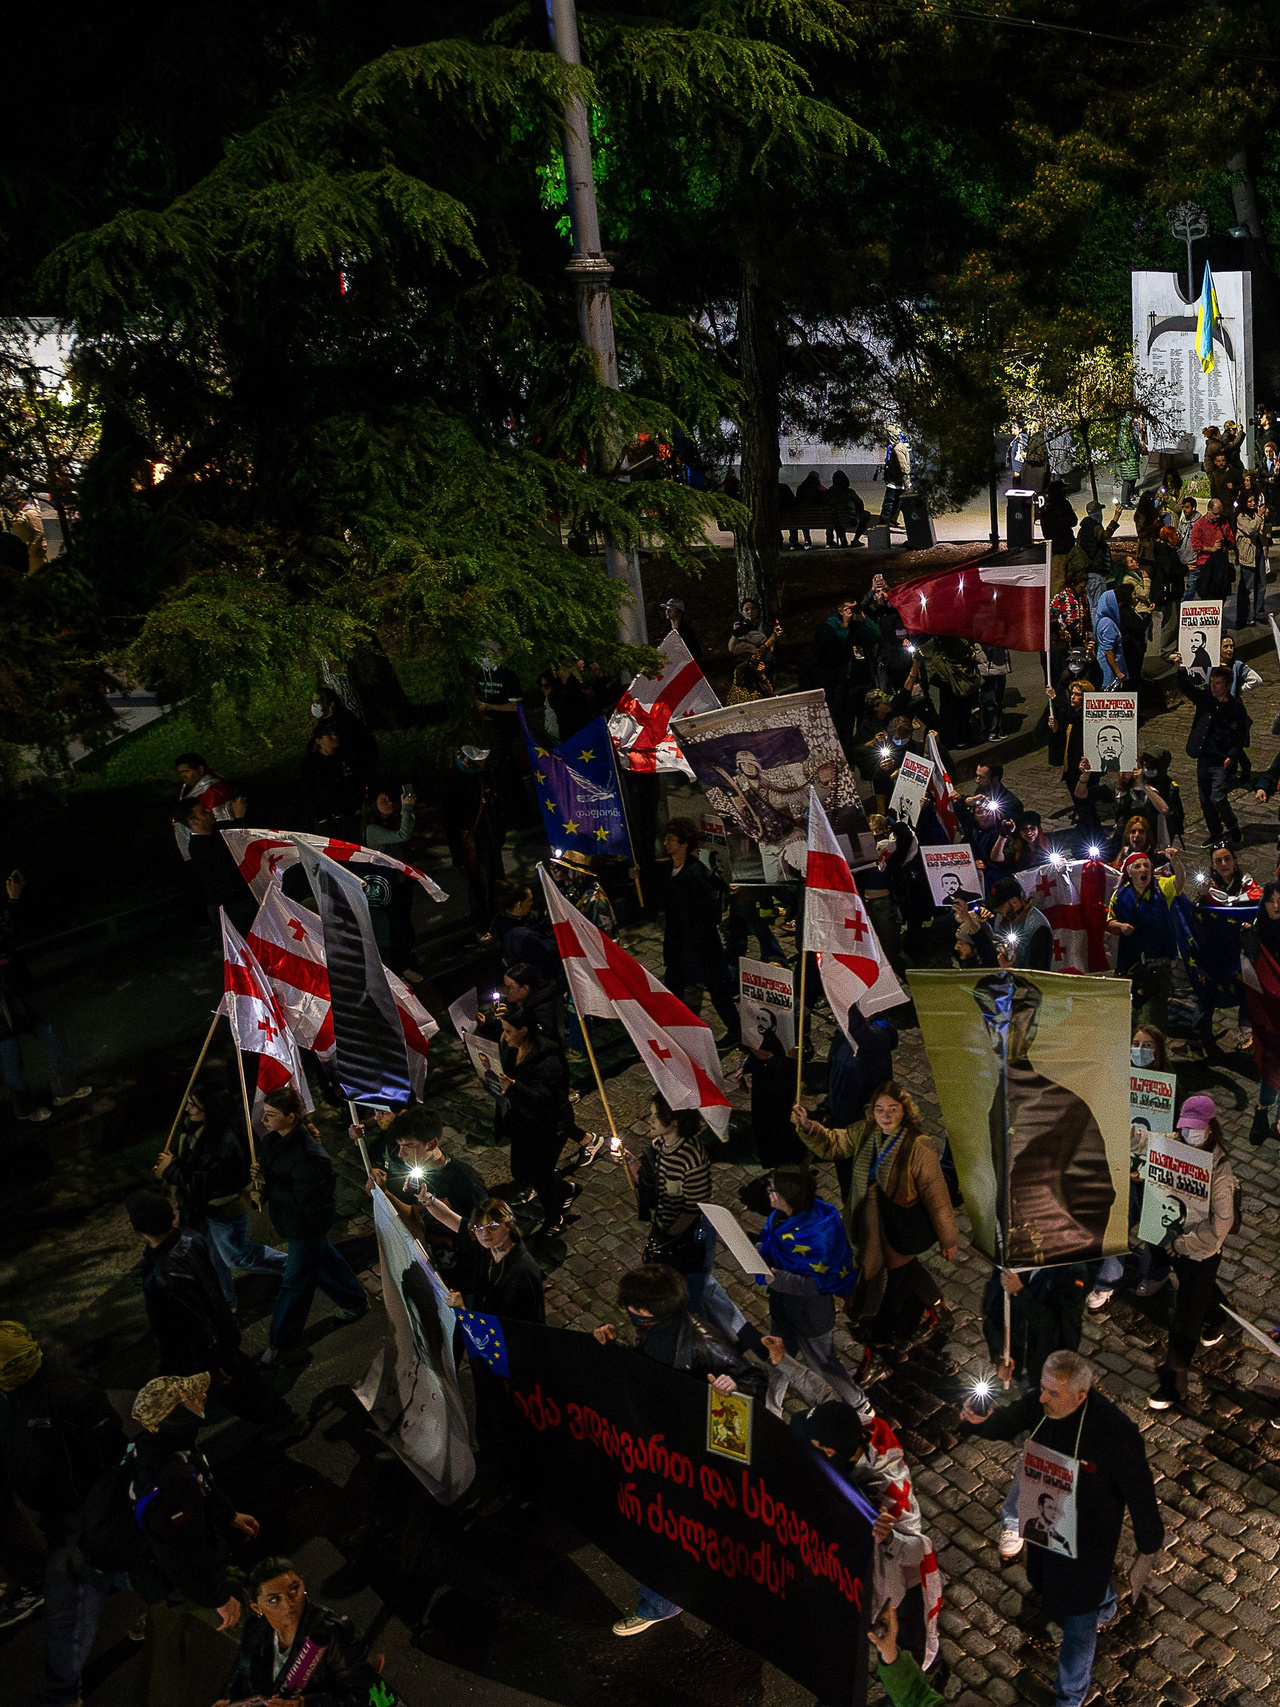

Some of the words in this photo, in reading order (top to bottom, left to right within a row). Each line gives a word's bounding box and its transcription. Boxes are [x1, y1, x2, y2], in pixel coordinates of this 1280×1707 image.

[1182, 606, 1220, 616] თავისუფლება
[1086, 699, 1135, 710] თავისუფლება
[925, 851, 970, 861] თავისუფლება
[742, 972, 792, 996] თავისუფლება
[1130, 1076, 1172, 1097] ისუფლება
[1148, 1164, 1174, 1186] ლუკა
[1149, 1150, 1210, 1183] თავისუფლება
[567, 1401, 696, 1489] ვდგავართ
[699, 1464, 738, 1510] და
[617, 1482, 643, 1526] არ
[286, 1642, 311, 1682] PIRVELI
